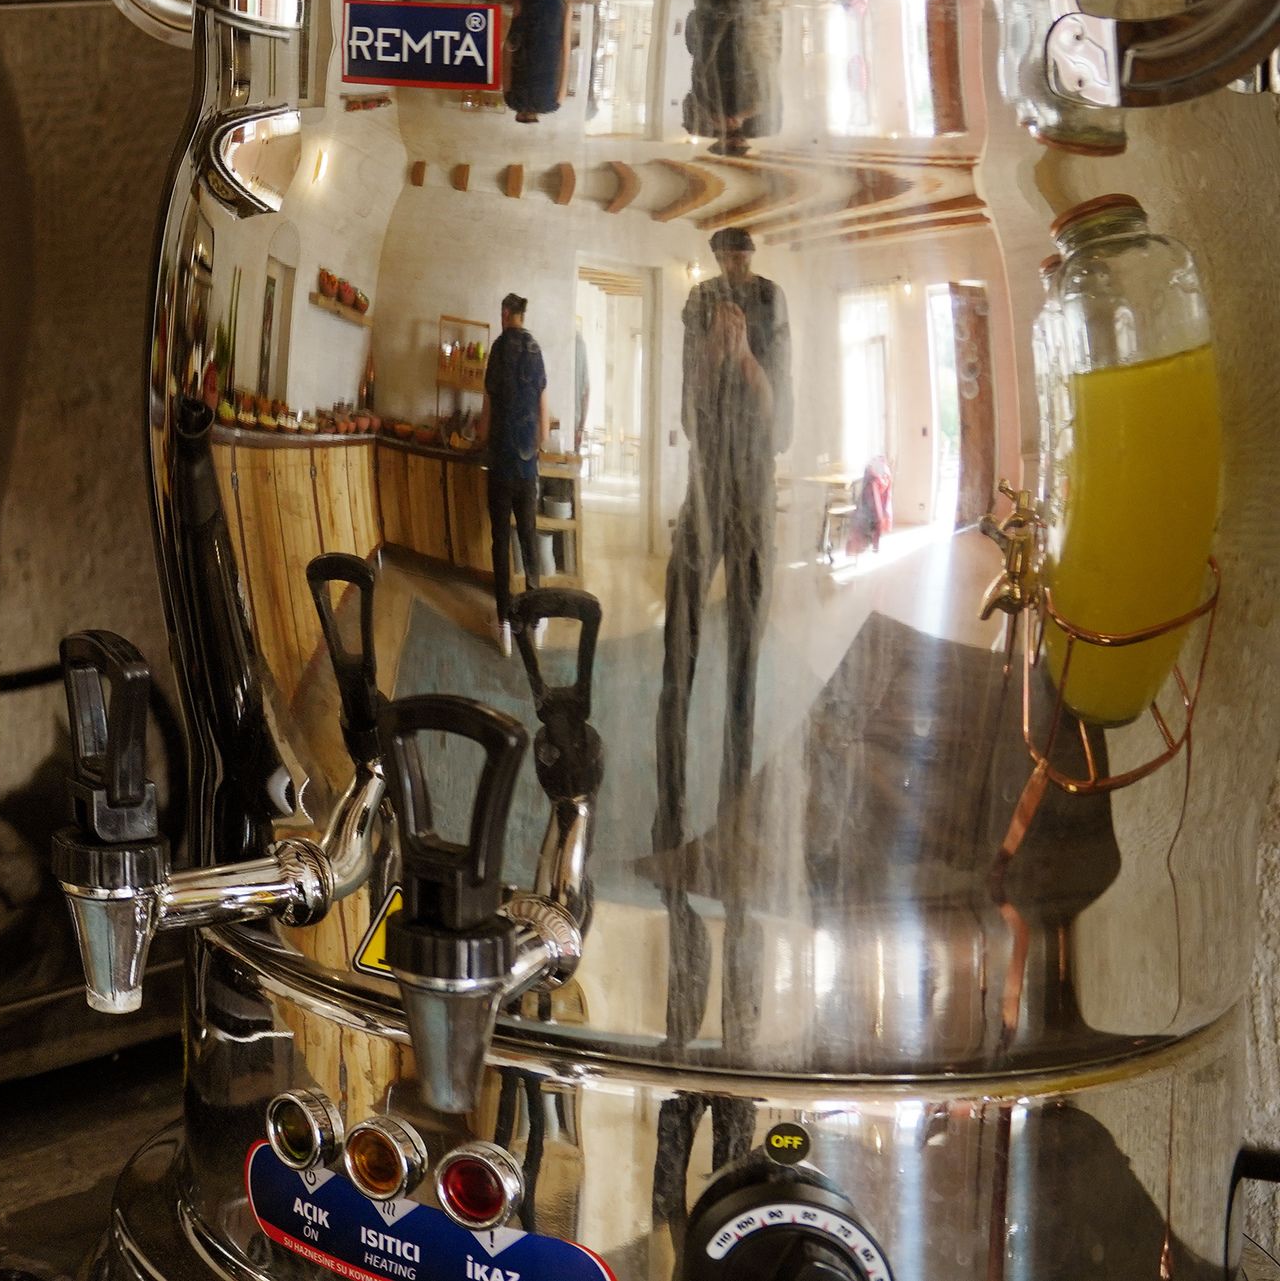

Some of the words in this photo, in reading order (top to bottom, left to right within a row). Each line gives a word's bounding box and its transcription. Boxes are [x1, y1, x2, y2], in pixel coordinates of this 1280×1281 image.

[770, 1134, 804, 1150] OFF
[293, 1197, 331, 1229] AÇIK
[303, 1225, 319, 1242] ON
[360, 1225, 421, 1263] ISITICI
[715, 1232, 732, 1248] 110
[736, 1216, 756, 1231] 100
[364, 1251, 417, 1281] HEATING
